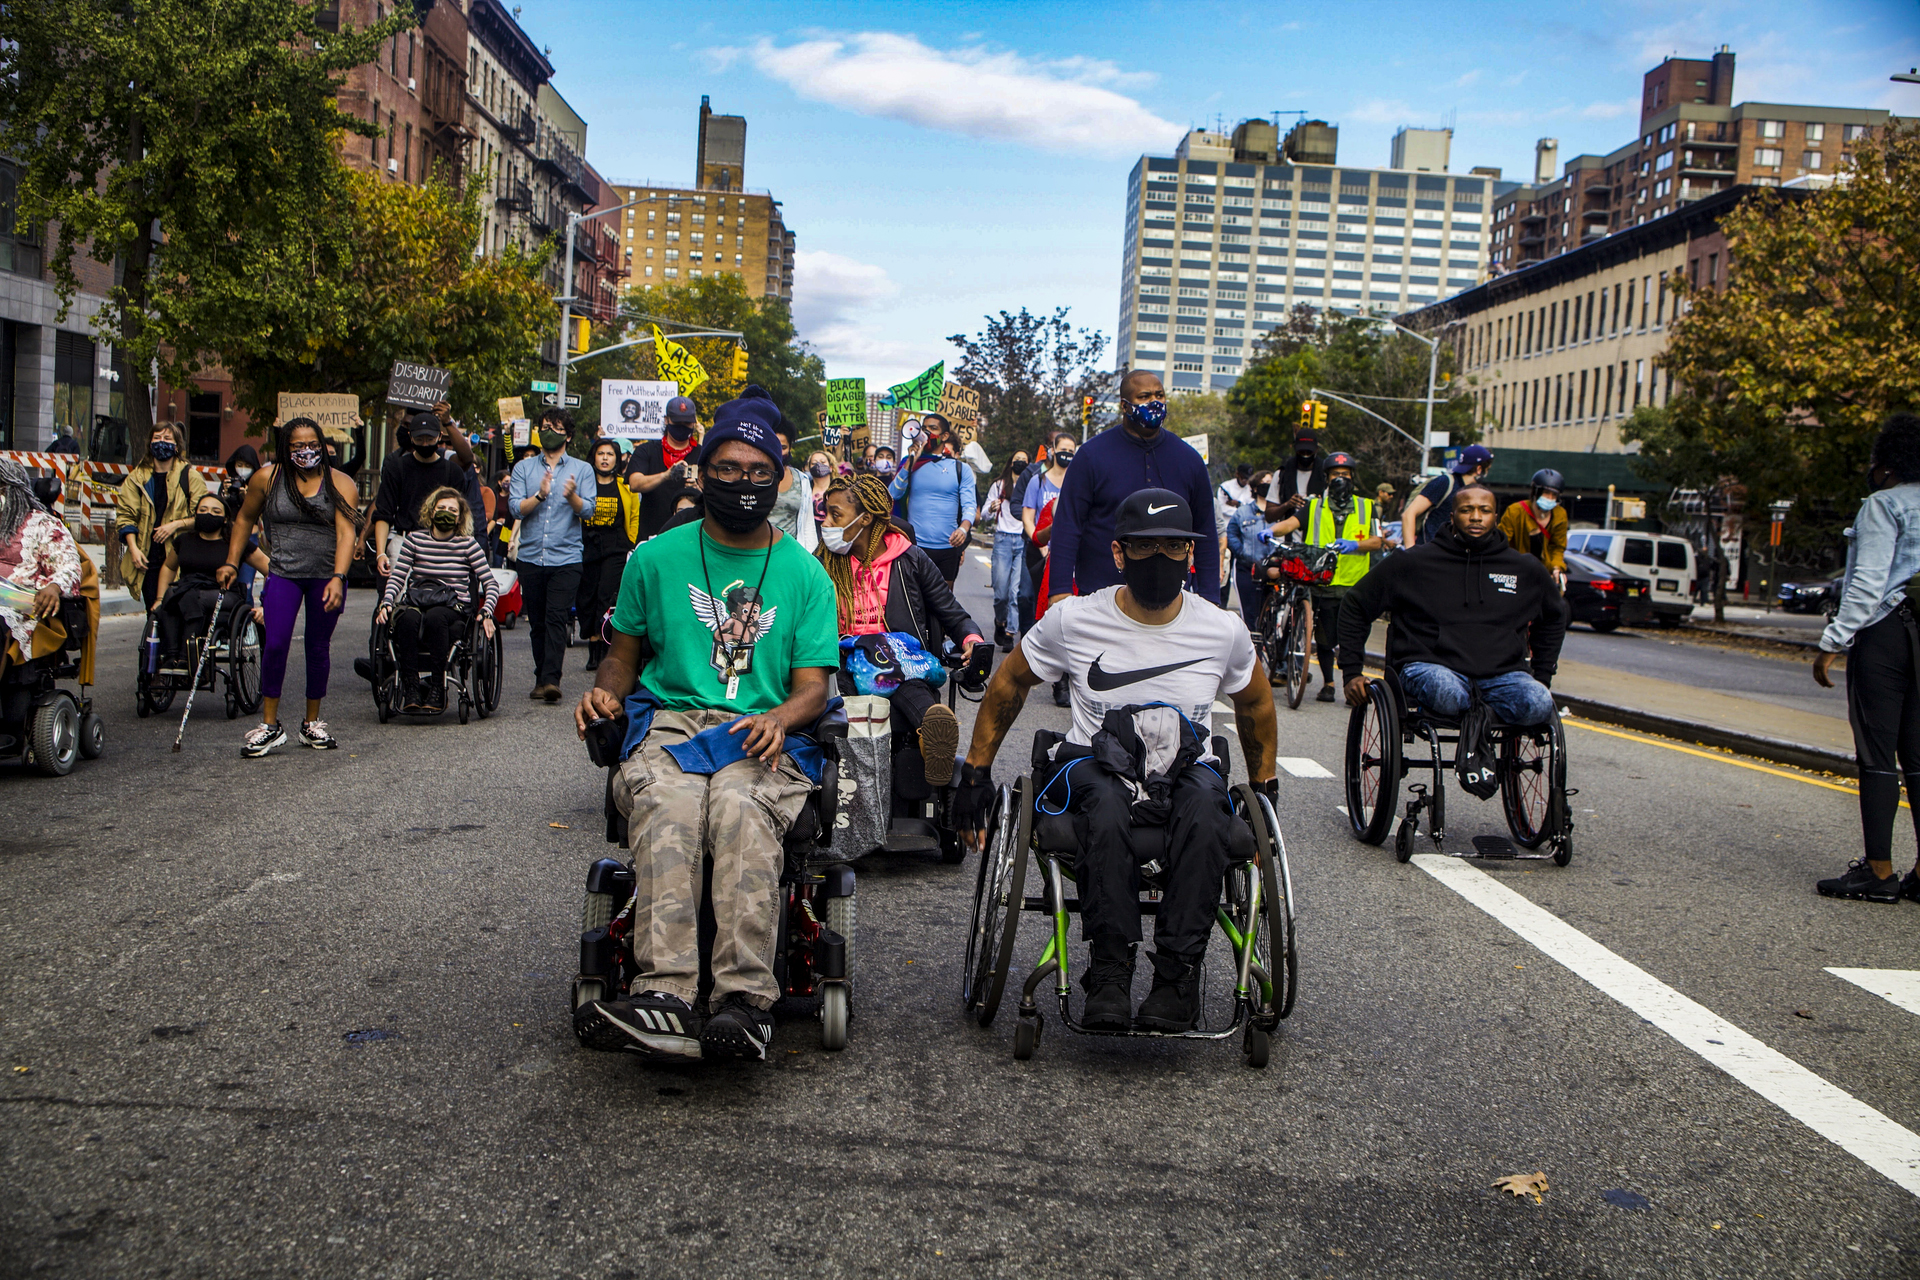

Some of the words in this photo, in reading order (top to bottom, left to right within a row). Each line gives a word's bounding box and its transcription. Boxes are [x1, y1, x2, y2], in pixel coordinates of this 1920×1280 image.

[394, 362, 450, 385] DISABLITY
[391, 381, 447, 402] SOLIDARITY
[608, 384, 623, 395] Free
[626, 384, 655, 397] Matthew
[830, 379, 860, 393] BLACK
[280, 396, 316, 408] BLACK
[827, 391, 865, 402] DISABLED
[833, 402, 860, 413] LIVES
[316, 411, 357, 425] MATTER
[828, 412, 866, 425] MATTER
